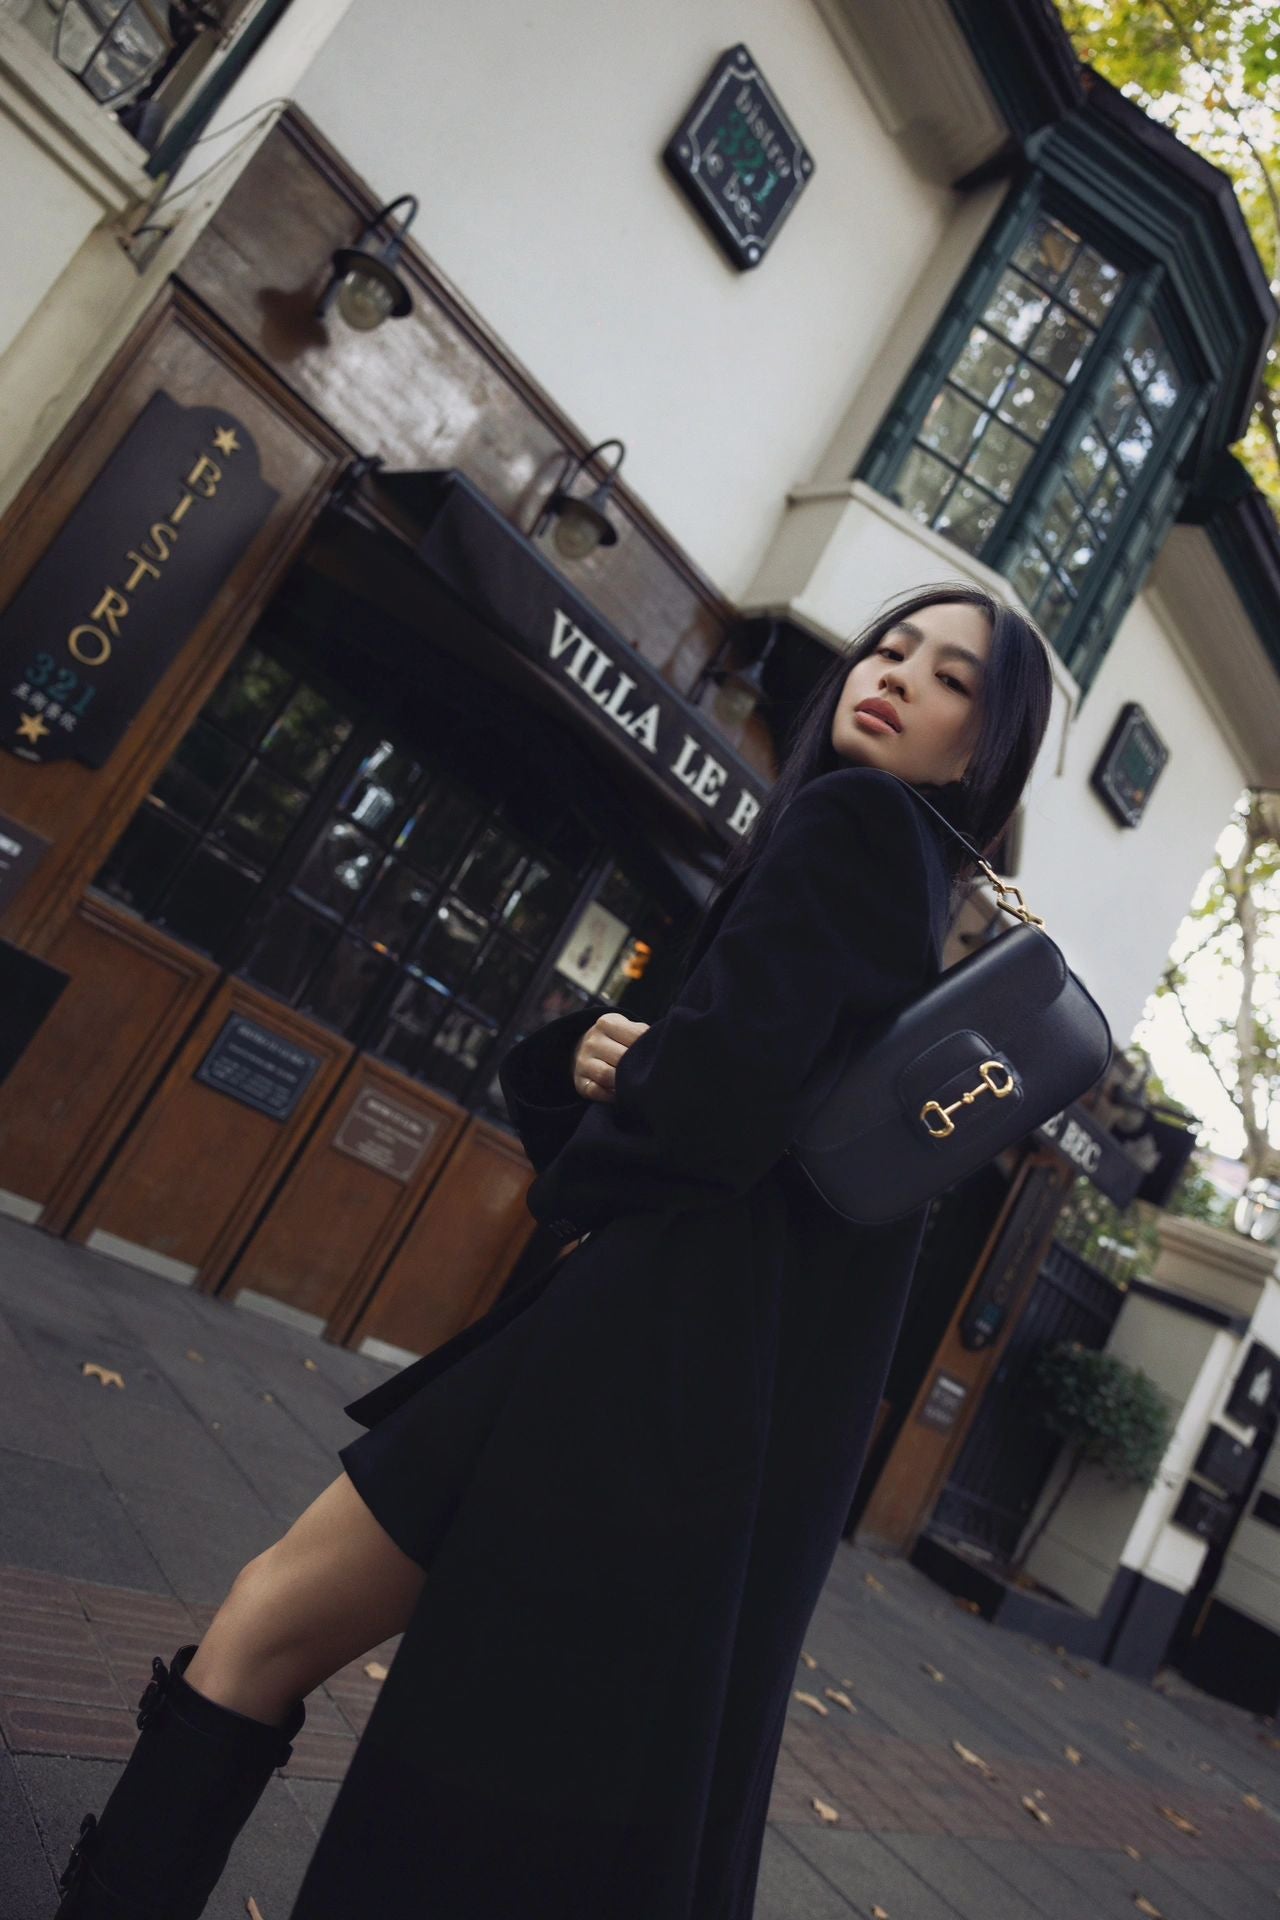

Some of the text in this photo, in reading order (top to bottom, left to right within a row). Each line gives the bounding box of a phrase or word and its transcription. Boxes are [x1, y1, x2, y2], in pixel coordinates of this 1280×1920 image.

[68, 453, 223, 667] BISTRO
[25, 652, 97, 718] 321
[548, 607, 661, 754] VILLA
[669, 734, 729, 808] LE
